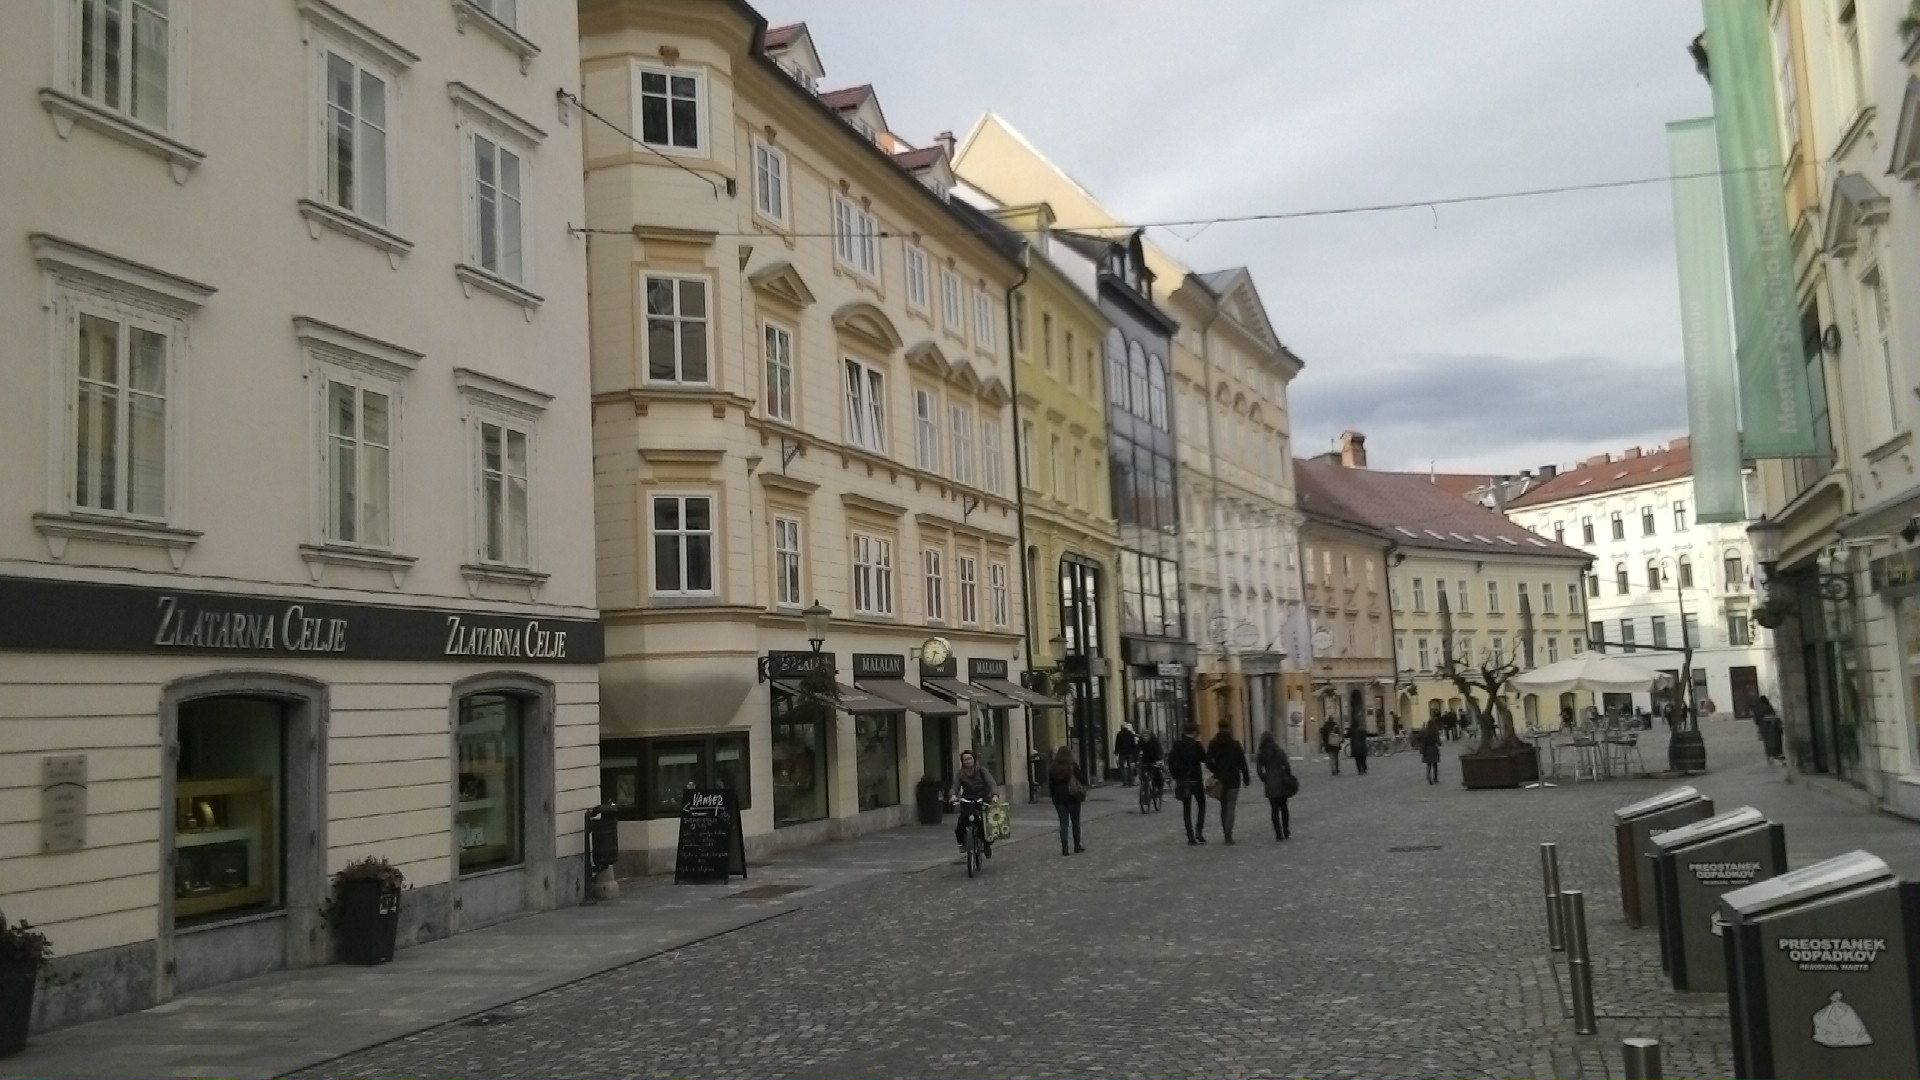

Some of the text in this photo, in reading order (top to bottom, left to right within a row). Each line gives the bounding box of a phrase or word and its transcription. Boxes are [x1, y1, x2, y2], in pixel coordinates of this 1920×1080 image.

[1763, 258, 1793, 345] galerija
[1776, 352, 1798, 434] Mestna
[154, 596, 348, 652] ZLATARNA CELJE
[444, 615, 567, 658] ZLATARNA CELJE
[862, 656, 901, 673] MALALAN
[976, 661, 1004, 674] MALALAN
[1688, 863, 1761, 871] PREOSTANEK
[1779, 938, 1886, 950] PREOSTANEK
[1789, 950, 1878, 962] ODPADKOV
